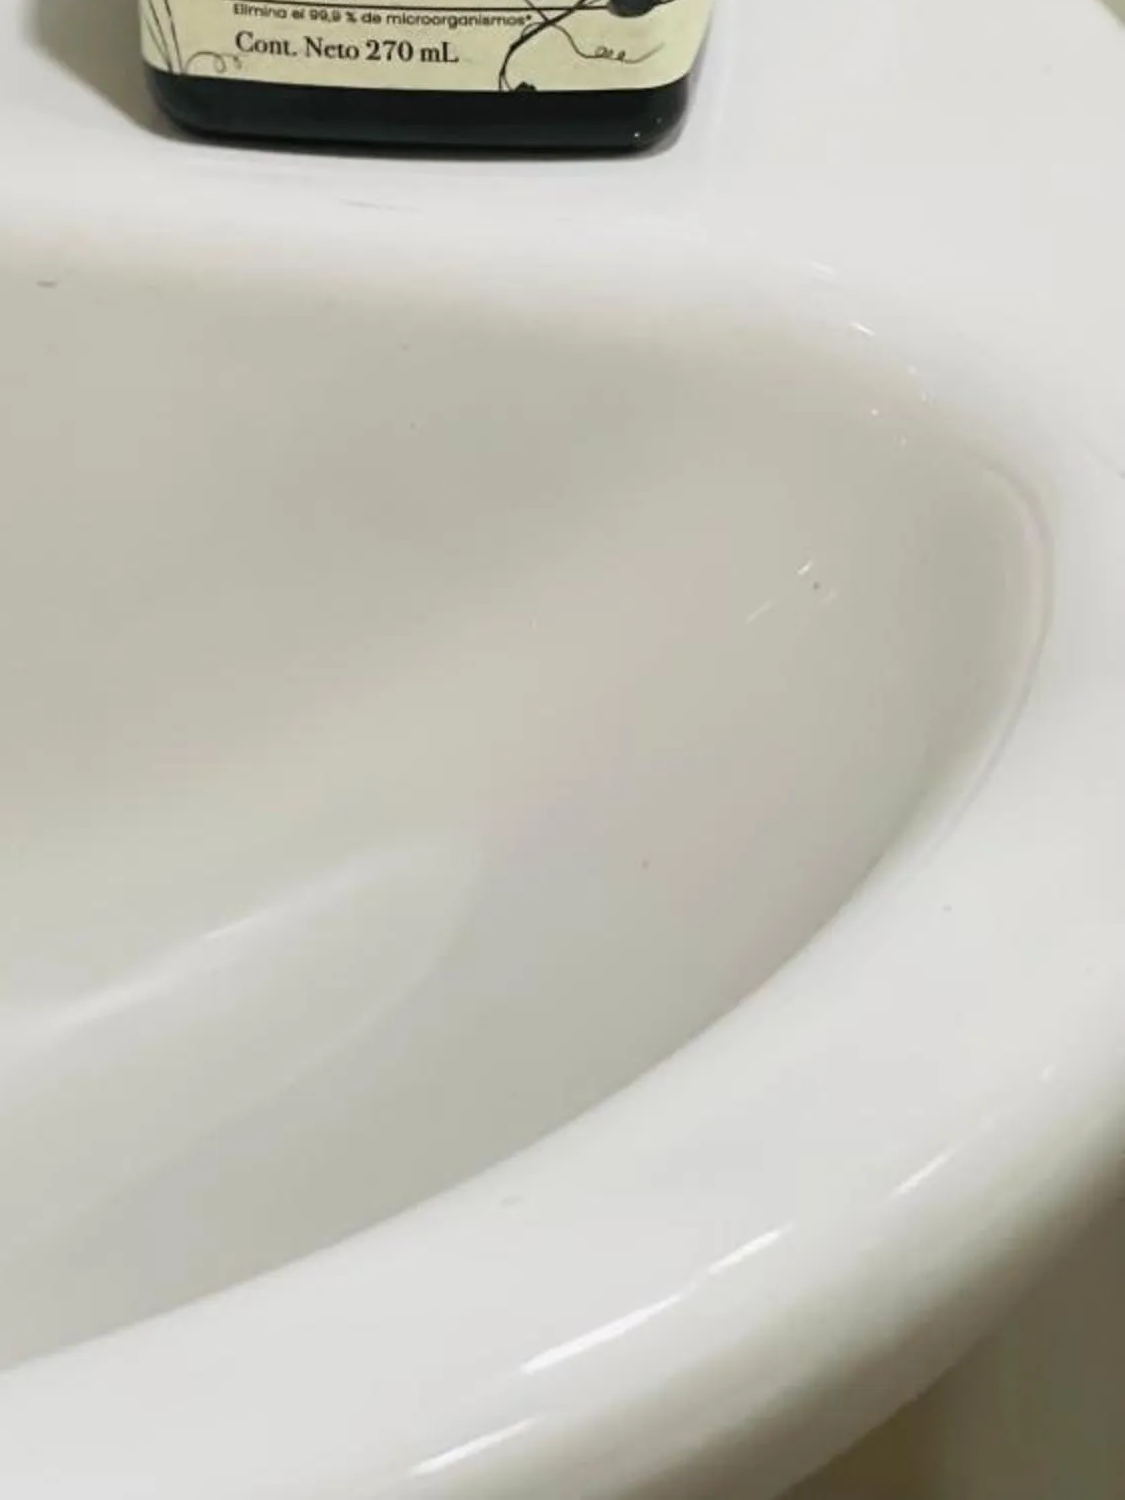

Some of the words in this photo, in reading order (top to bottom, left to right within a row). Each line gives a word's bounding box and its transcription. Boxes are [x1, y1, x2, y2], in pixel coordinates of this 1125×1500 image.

[233, 3, 287, 19] Elimina
[360, 11, 381, 24] de
[235, 30, 297, 56] Cont.
[303, 35, 360, 60] Neto
[363, 39, 414, 61] 270
[420, 41, 459, 63] mL
